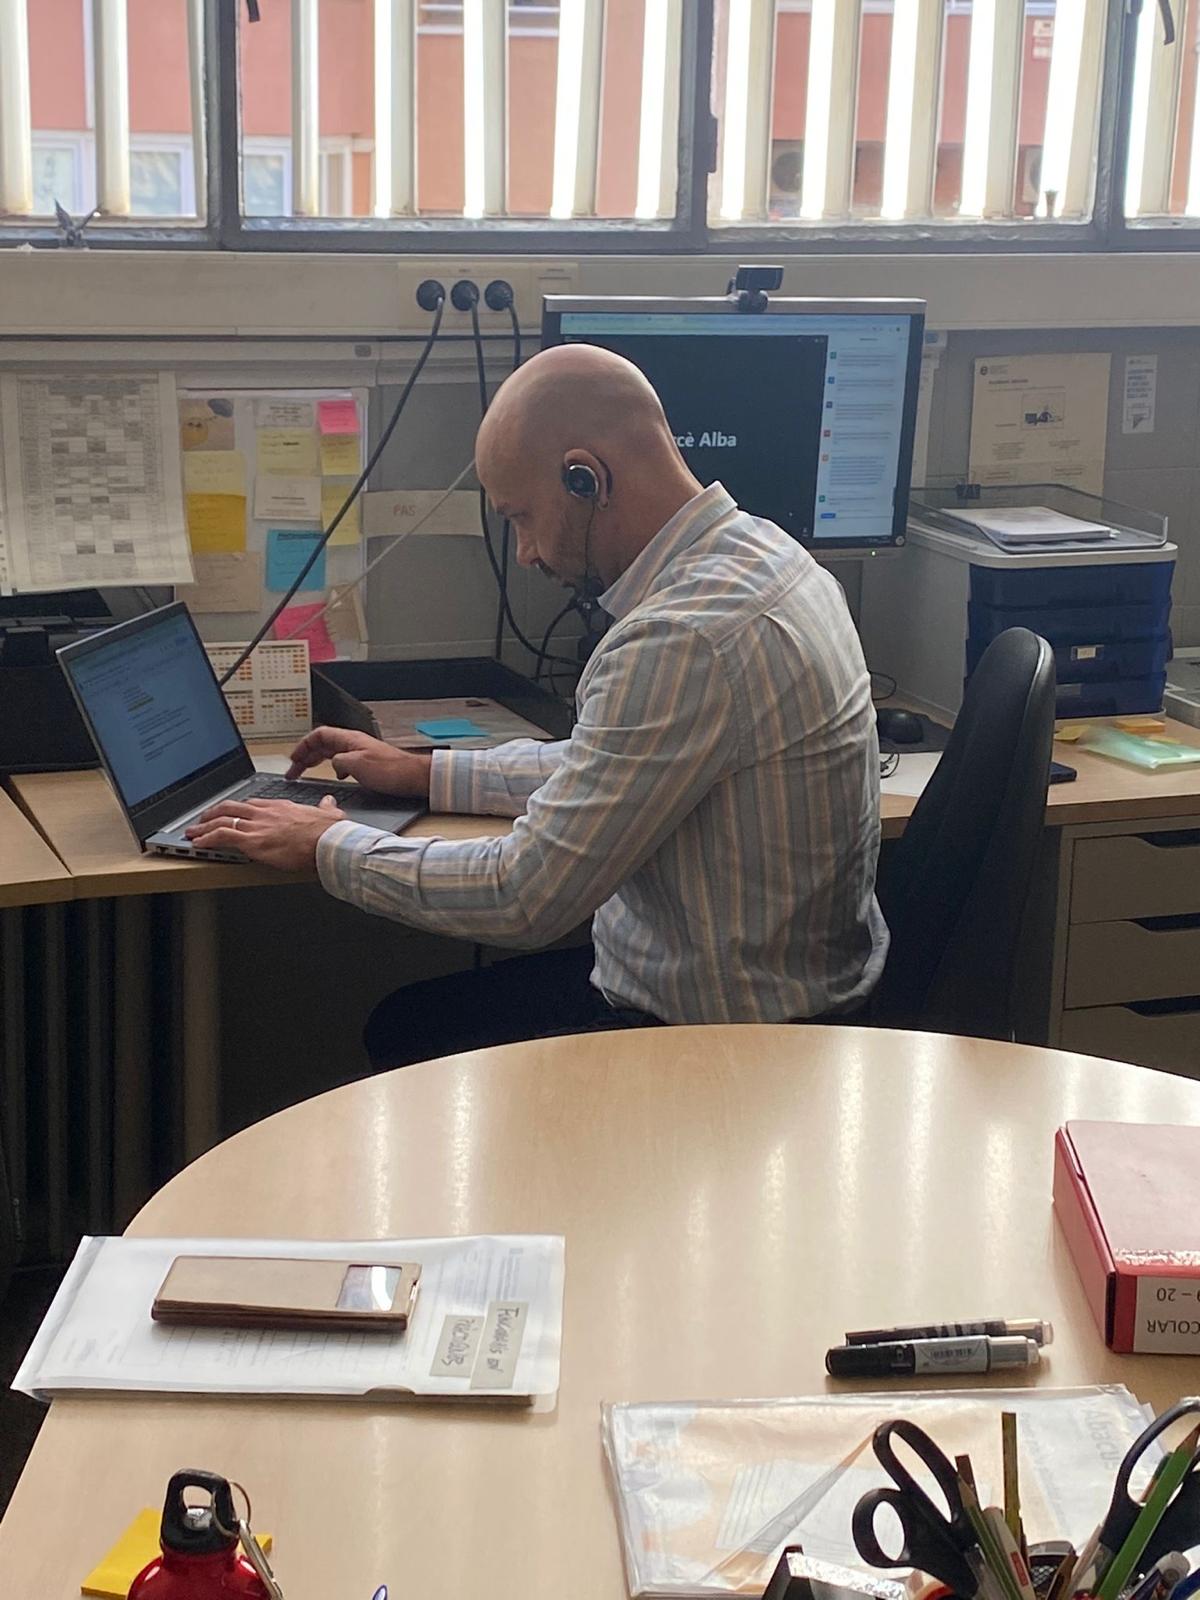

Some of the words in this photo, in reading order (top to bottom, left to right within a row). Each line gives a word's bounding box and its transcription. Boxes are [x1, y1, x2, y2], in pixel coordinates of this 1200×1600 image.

[699, 432, 737, 447] Alba
[1157, 1287, 1176, 1301] 20
[1146, 1319, 1200, 1334] COLAR
